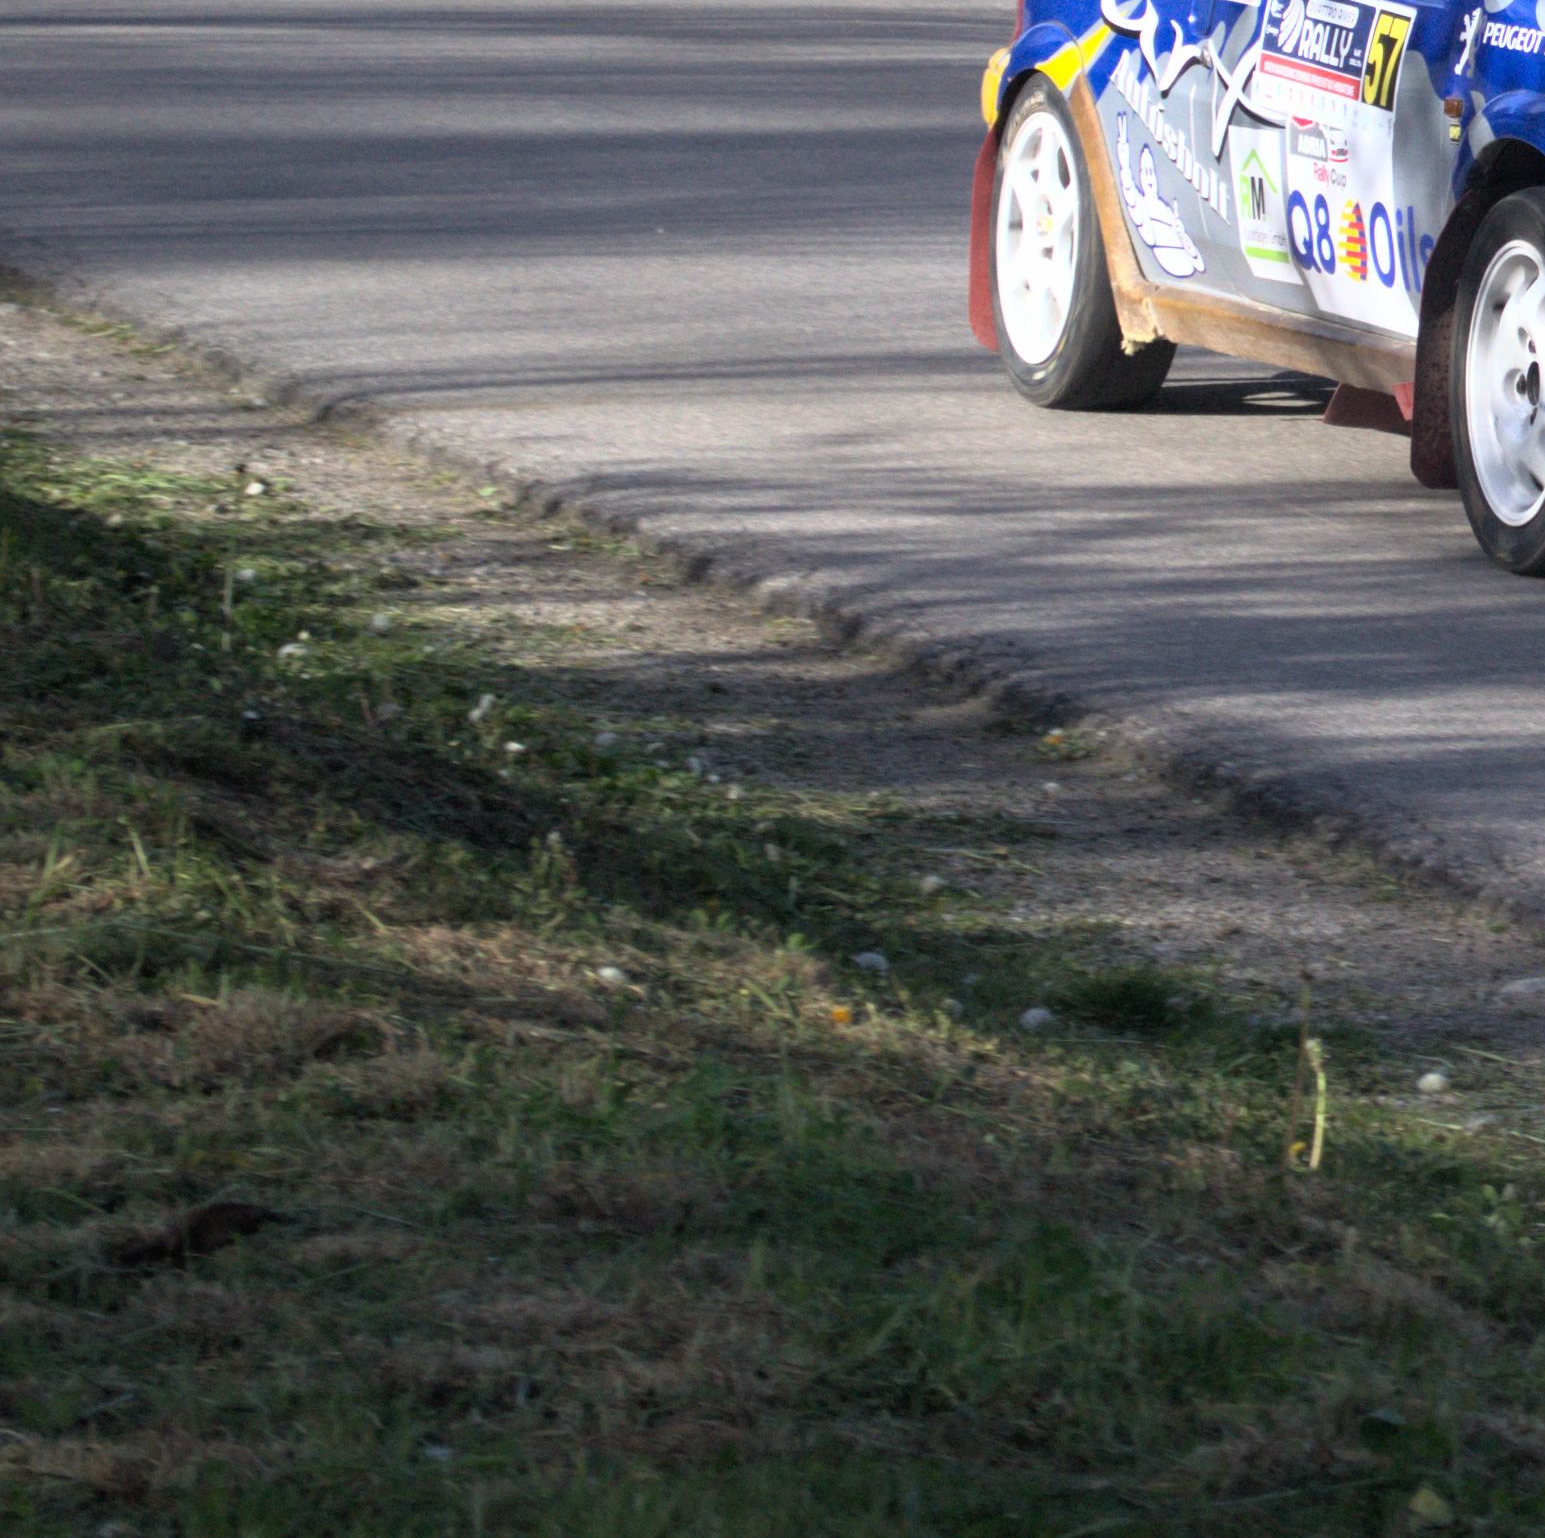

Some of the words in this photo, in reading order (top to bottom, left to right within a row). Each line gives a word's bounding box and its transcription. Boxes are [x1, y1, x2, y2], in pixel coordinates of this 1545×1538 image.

[1298, 19, 1354, 68] RALLY
[1364, 13, 1410, 108] 57
[1298, 134, 1327, 158] ADRIA
[1330, 168, 1347, 190] Cup
[1287, 190, 1336, 275] Q8
